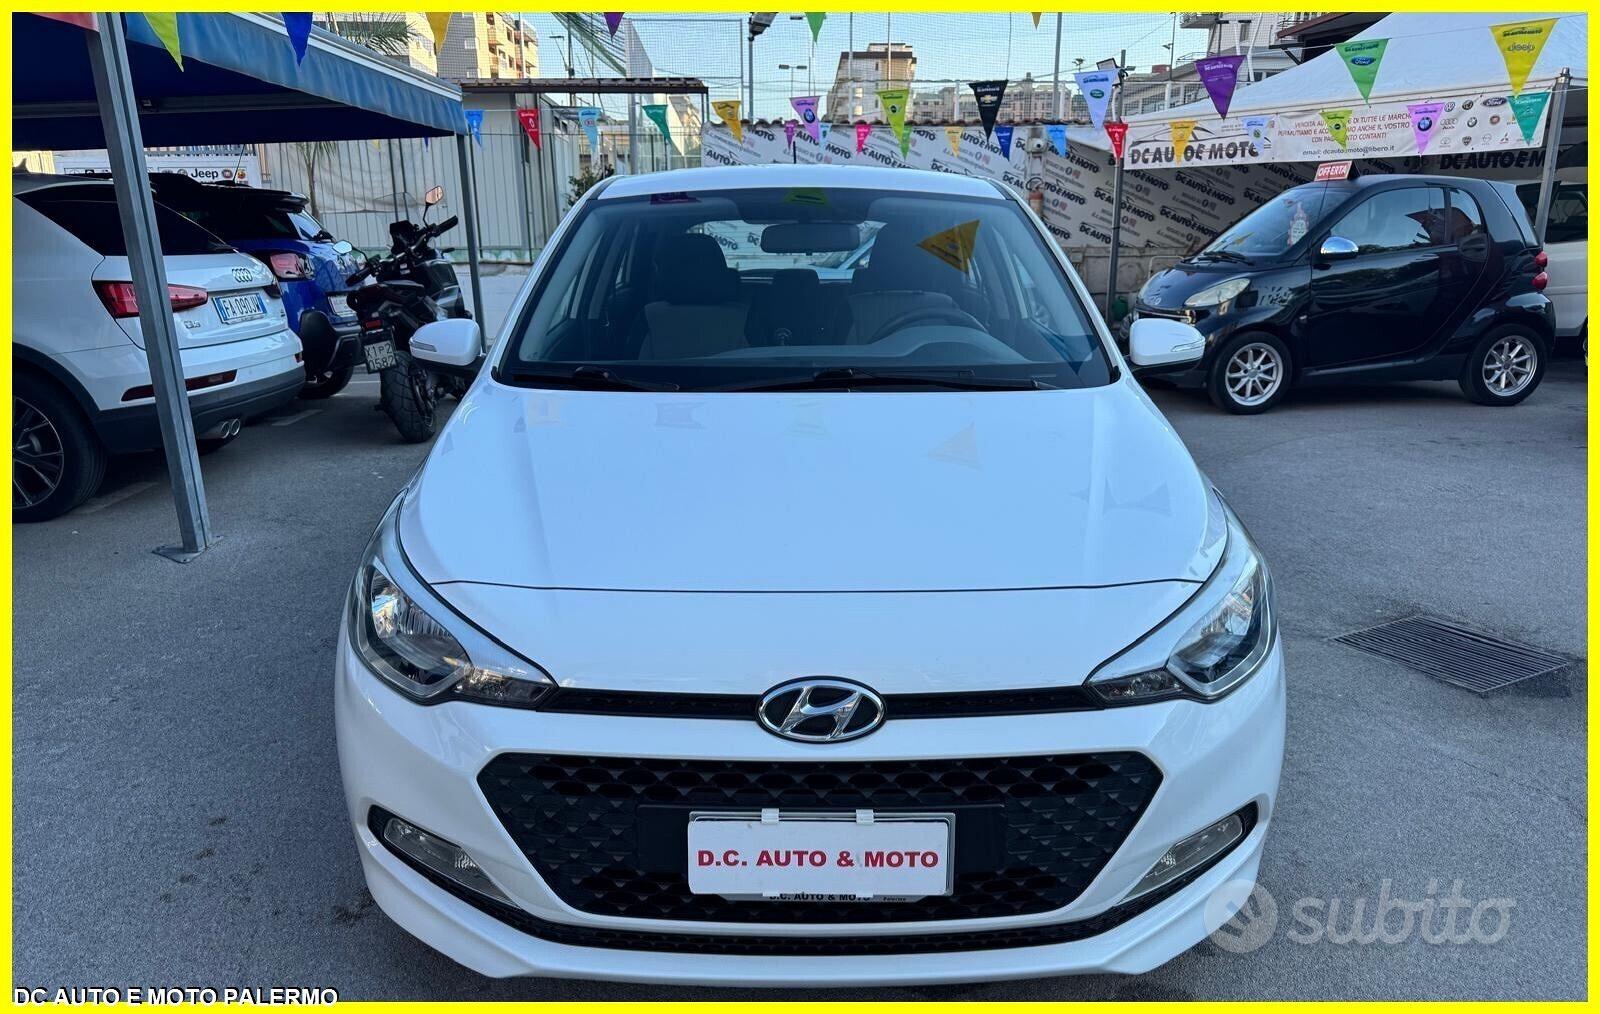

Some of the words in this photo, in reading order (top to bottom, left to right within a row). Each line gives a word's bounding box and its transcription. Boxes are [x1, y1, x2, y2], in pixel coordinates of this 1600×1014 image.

[1152, 145, 1193, 162] AUO
[191, 168, 219, 180] Jeep
[698, 850, 747, 867] D.C.
[756, 850, 827, 867] AUTO
[836, 850, 854, 867] &
[865, 850, 938, 868] MOTO
